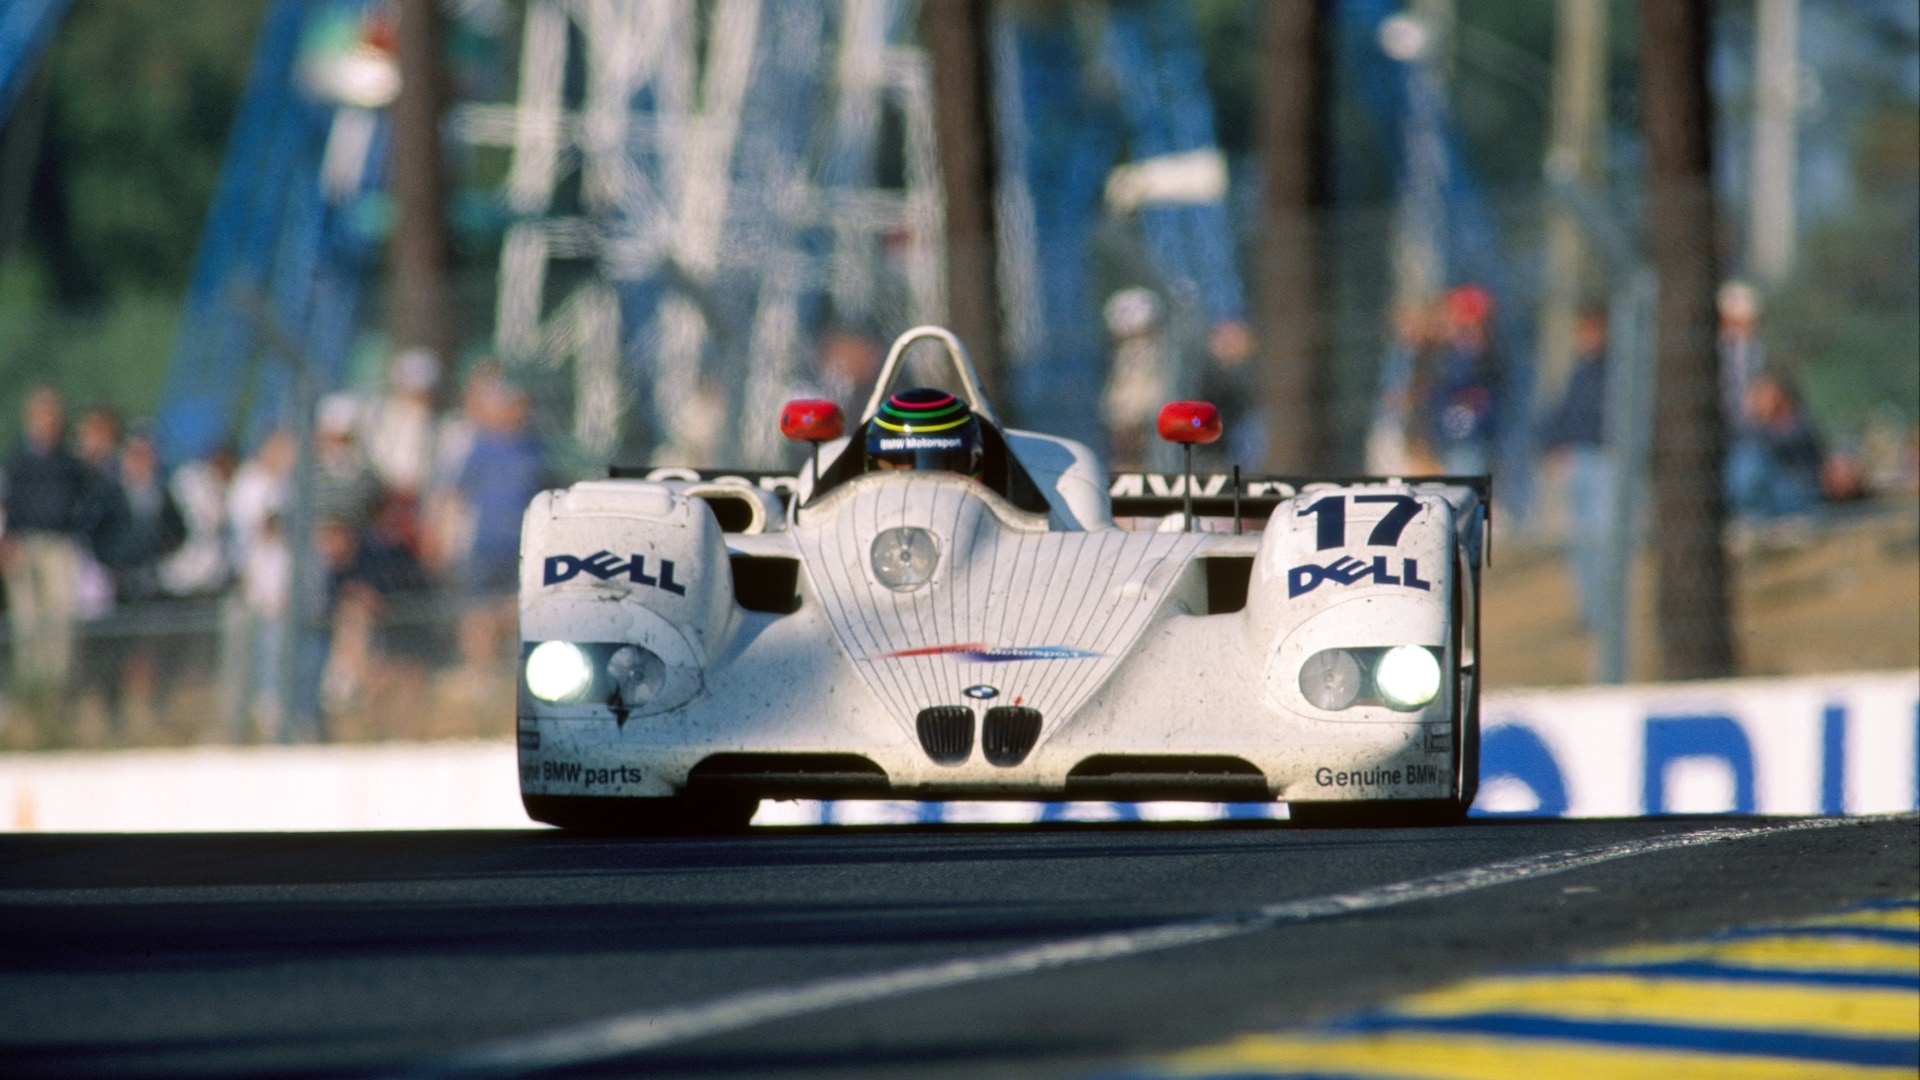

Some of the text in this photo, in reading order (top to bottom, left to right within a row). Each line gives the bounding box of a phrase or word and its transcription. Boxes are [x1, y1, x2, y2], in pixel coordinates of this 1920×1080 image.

[880, 438, 962, 450] BMW Motorsport
[1297, 495, 1423, 552] 17
[543, 550, 685, 597] DELL
[1288, 555, 1430, 599] DELL
[543, 761, 581, 783] BMW
[584, 764, 642, 787] parts
[1315, 765, 1401, 788] Genuine
[1406, 764, 1438, 785] BMW
